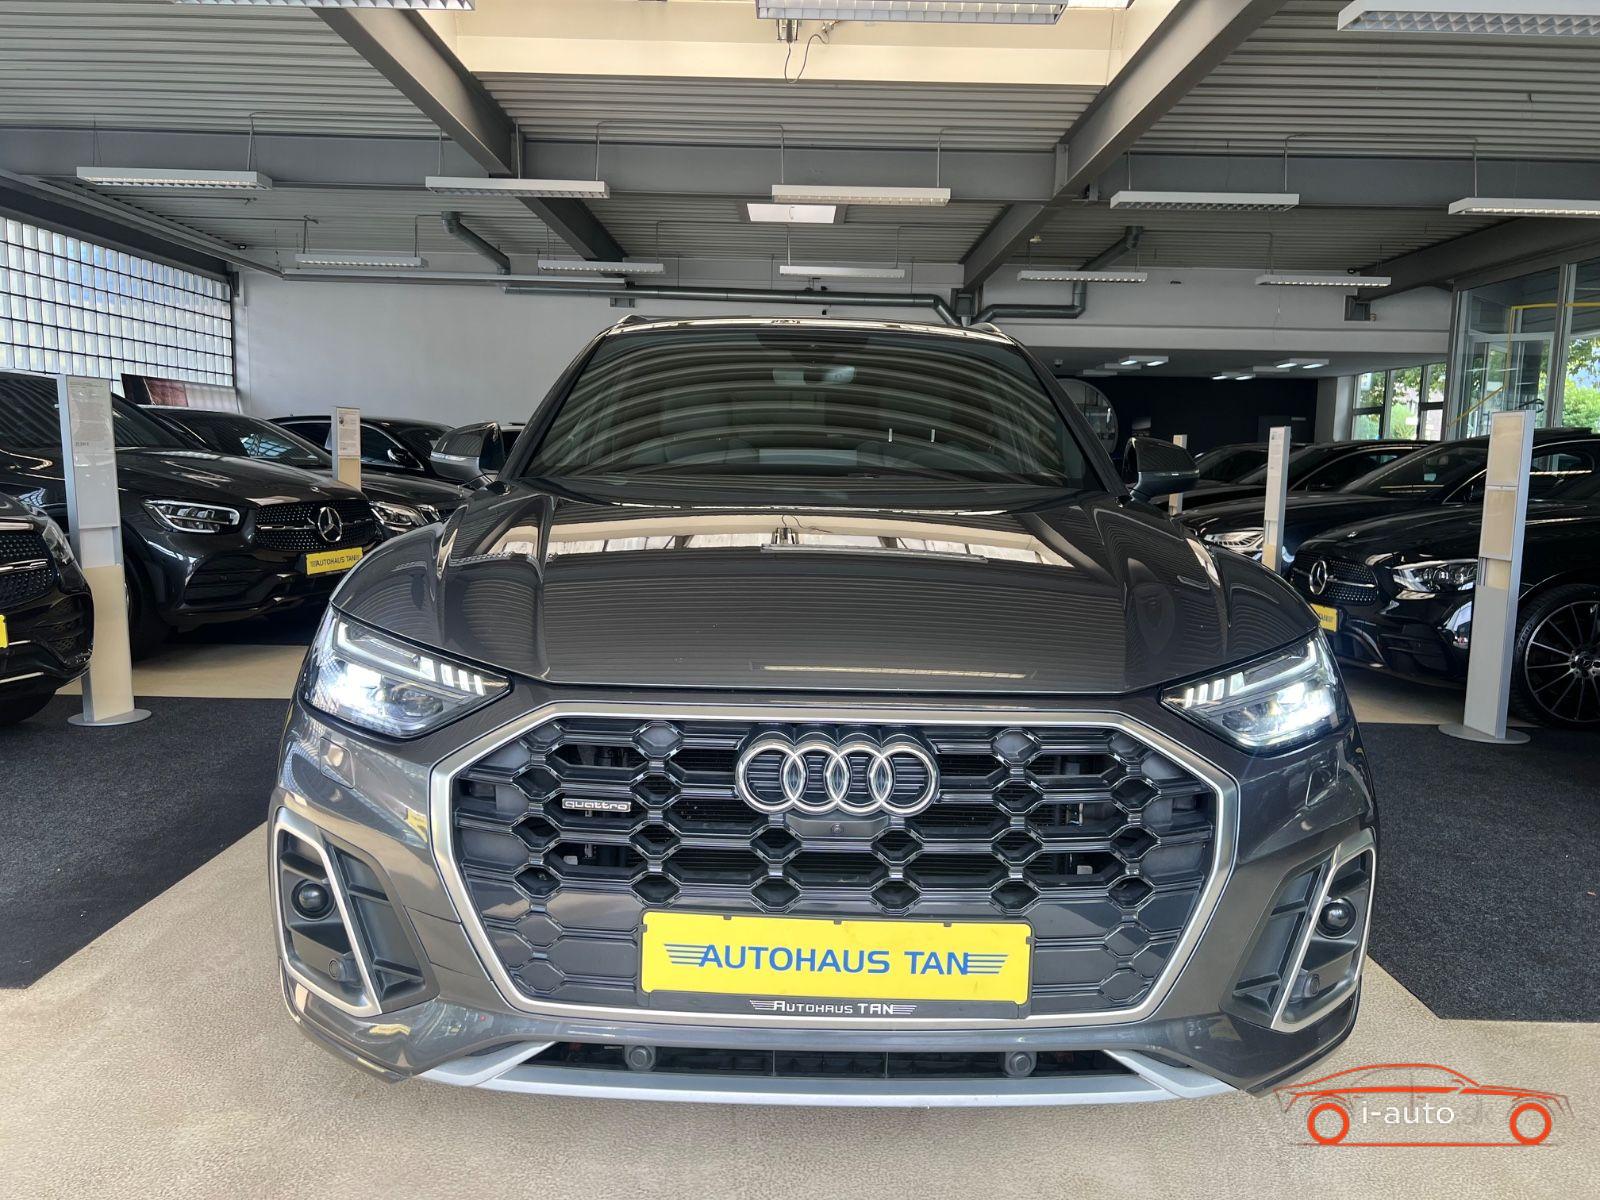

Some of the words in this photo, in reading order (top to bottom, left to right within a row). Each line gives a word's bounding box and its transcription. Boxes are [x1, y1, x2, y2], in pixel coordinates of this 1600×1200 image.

[565, 800, 627, 810] quattro
[699, 944, 890, 974] AUTOHAUS
[904, 951, 969, 976] TAN
[857, 1003, 894, 1015] TAN
